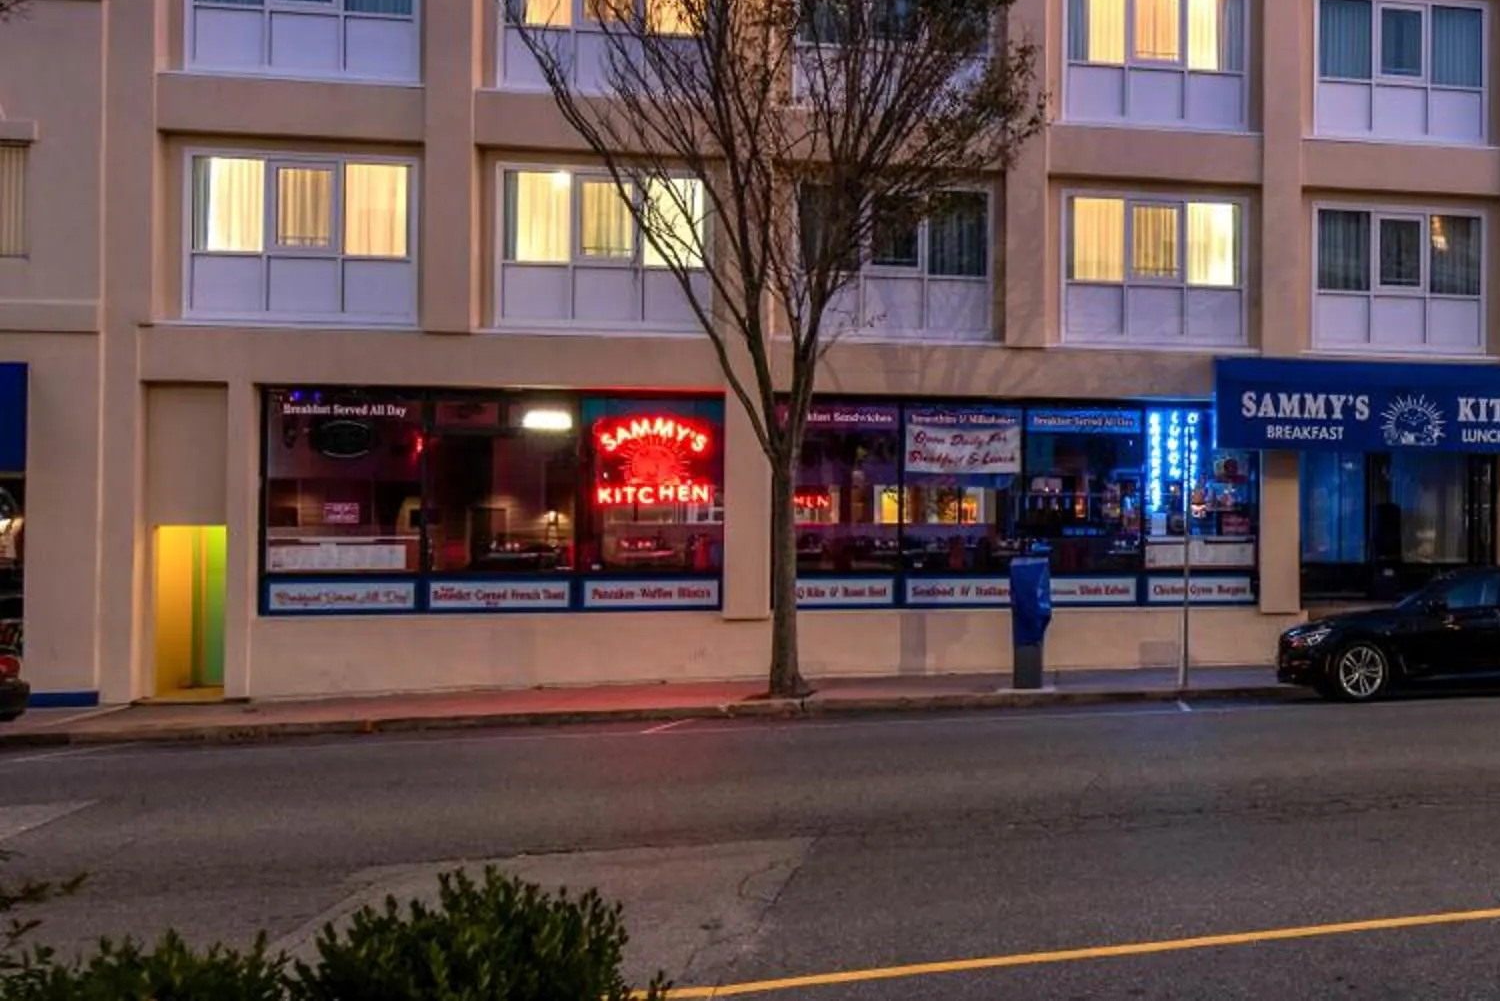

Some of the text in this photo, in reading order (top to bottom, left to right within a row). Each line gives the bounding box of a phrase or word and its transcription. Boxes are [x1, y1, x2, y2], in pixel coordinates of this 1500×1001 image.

[333, 404, 368, 416] Served
[370, 404, 385, 416] All
[386, 405, 407, 418] Day
[1241, 391, 1370, 421] SAMMY'S
[601, 417, 708, 452] SAMMY'S
[1266, 424, 1344, 440] BREAKFAST
[598, 485, 708, 504] KITCHEN
